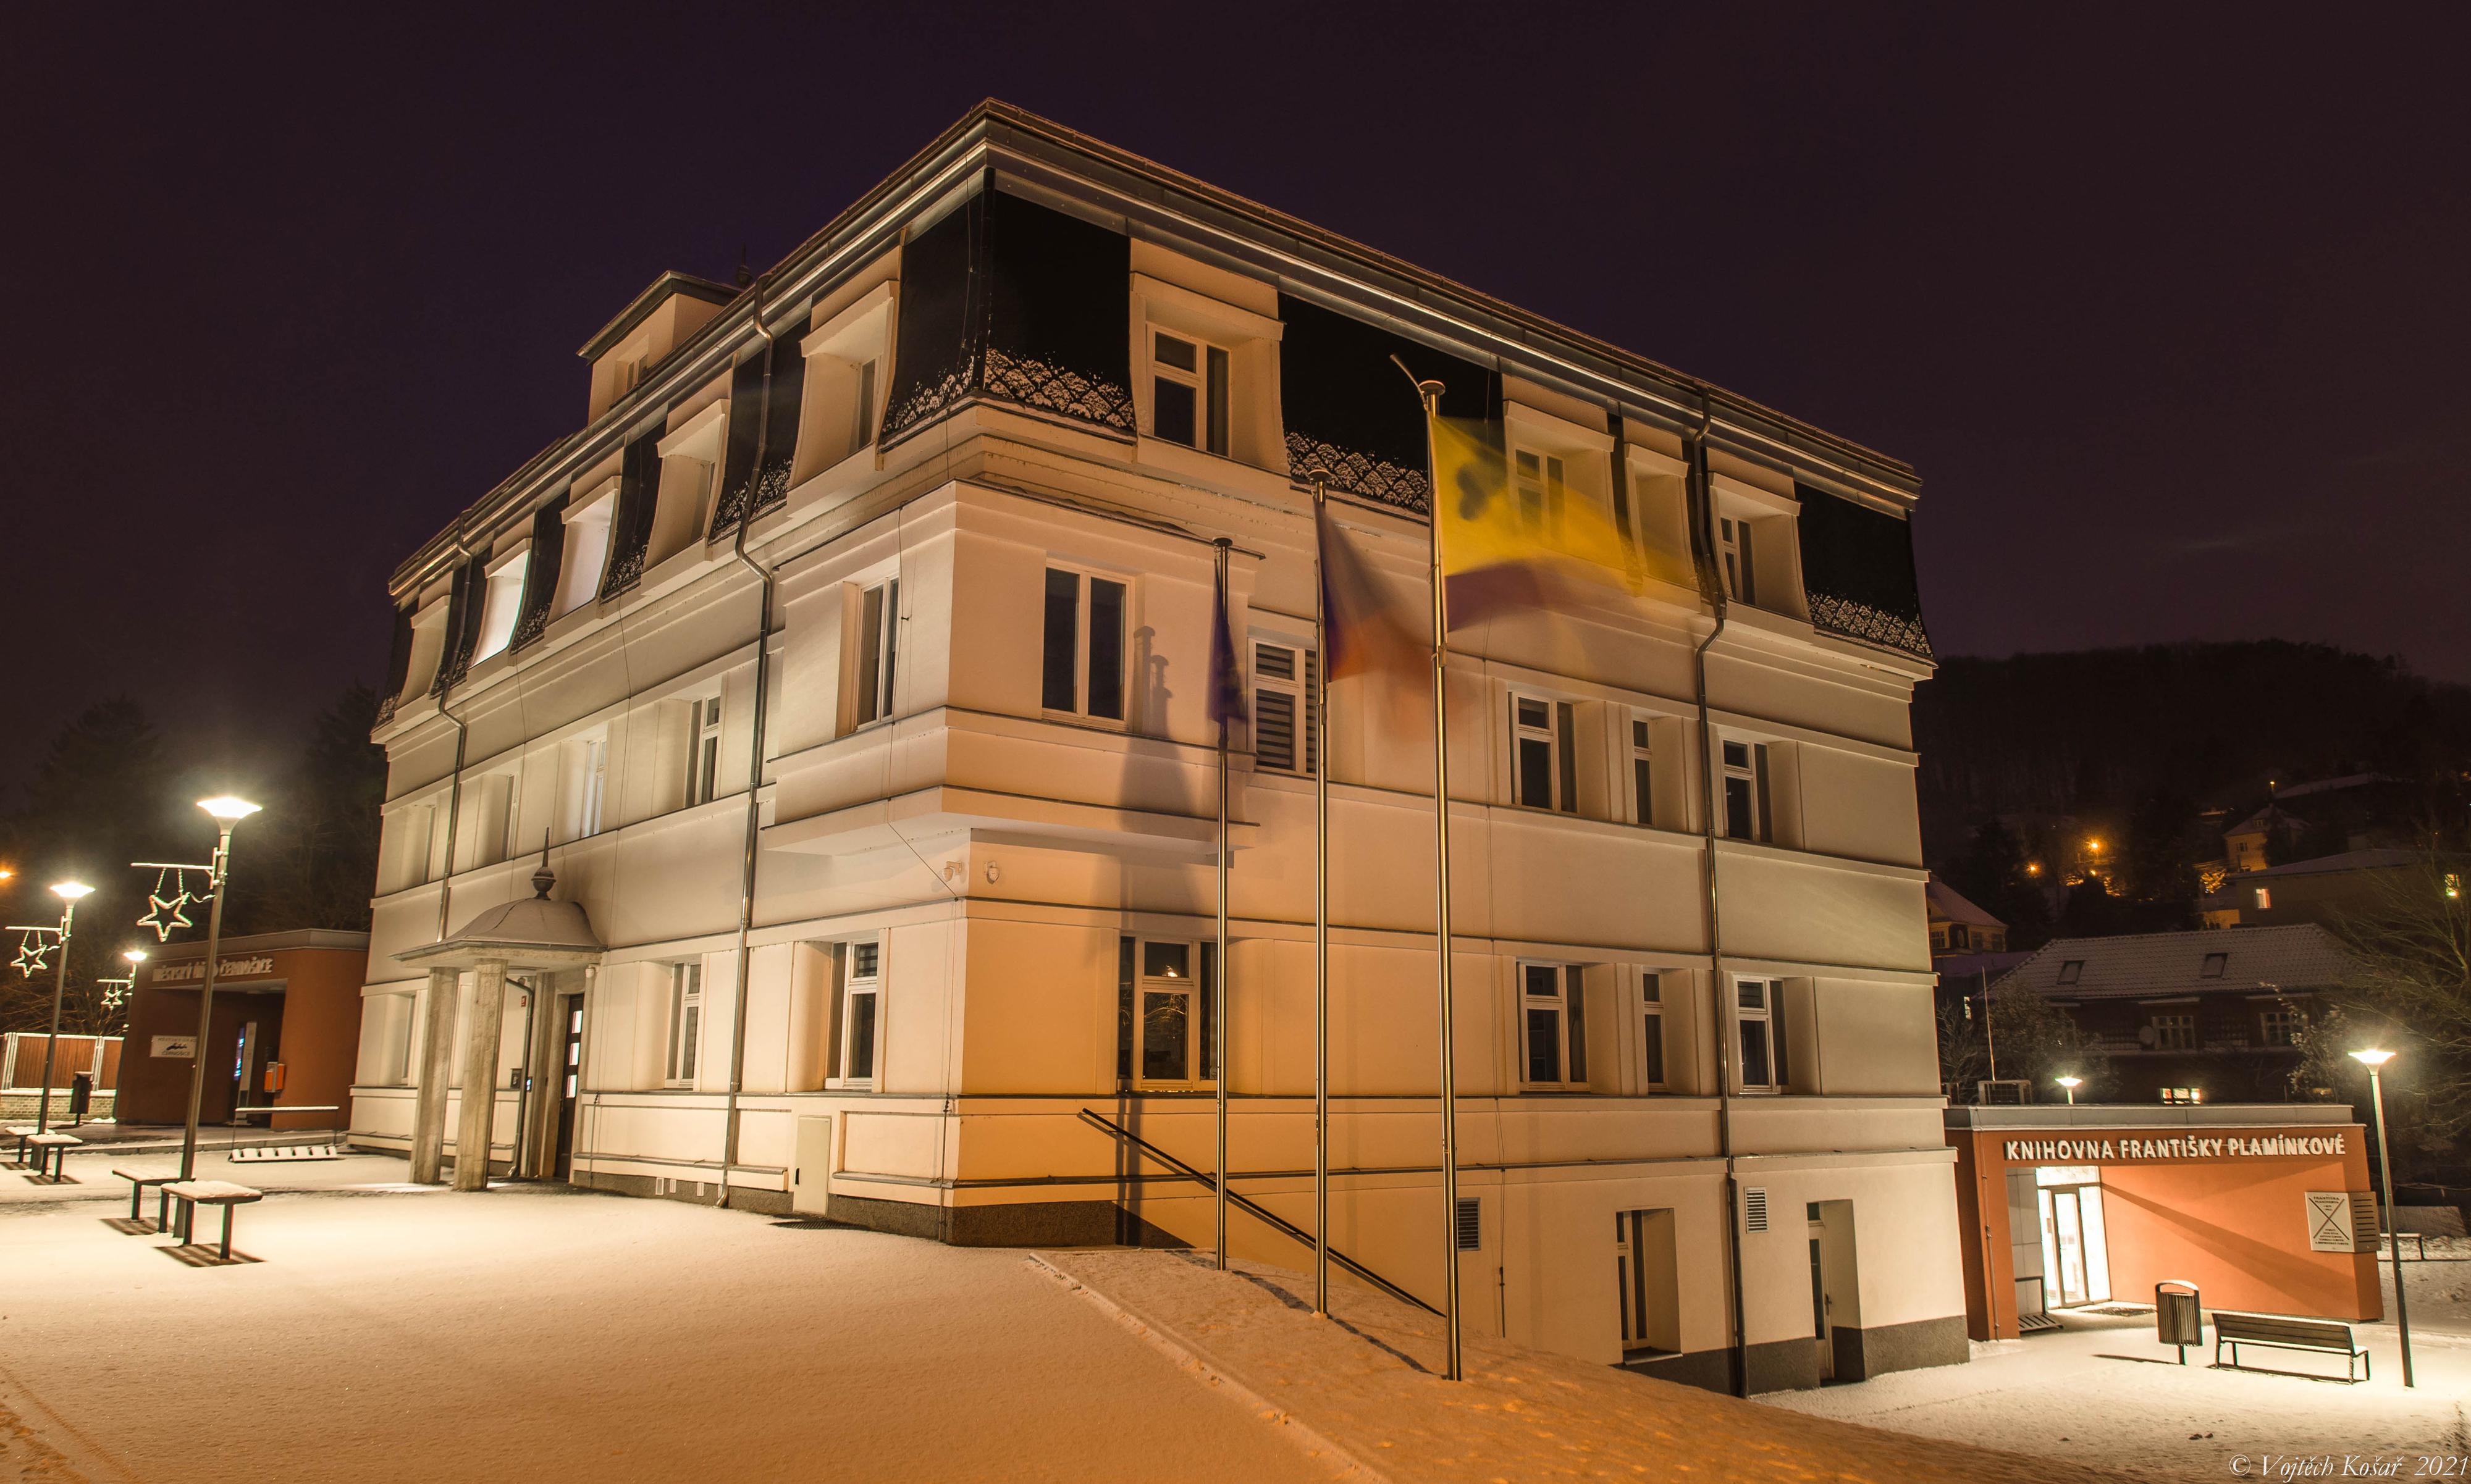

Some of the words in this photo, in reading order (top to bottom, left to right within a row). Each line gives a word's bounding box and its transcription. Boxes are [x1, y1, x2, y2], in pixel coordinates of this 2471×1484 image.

[192, 961, 219, 979] ÚŘD
[2005, 1140, 2115, 1160] KNIHOVNA
[2118, 1134, 2223, 1159] FRANTIŠKY
[2227, 1133, 2346, 1157] PLAMÍNKOVÉ
